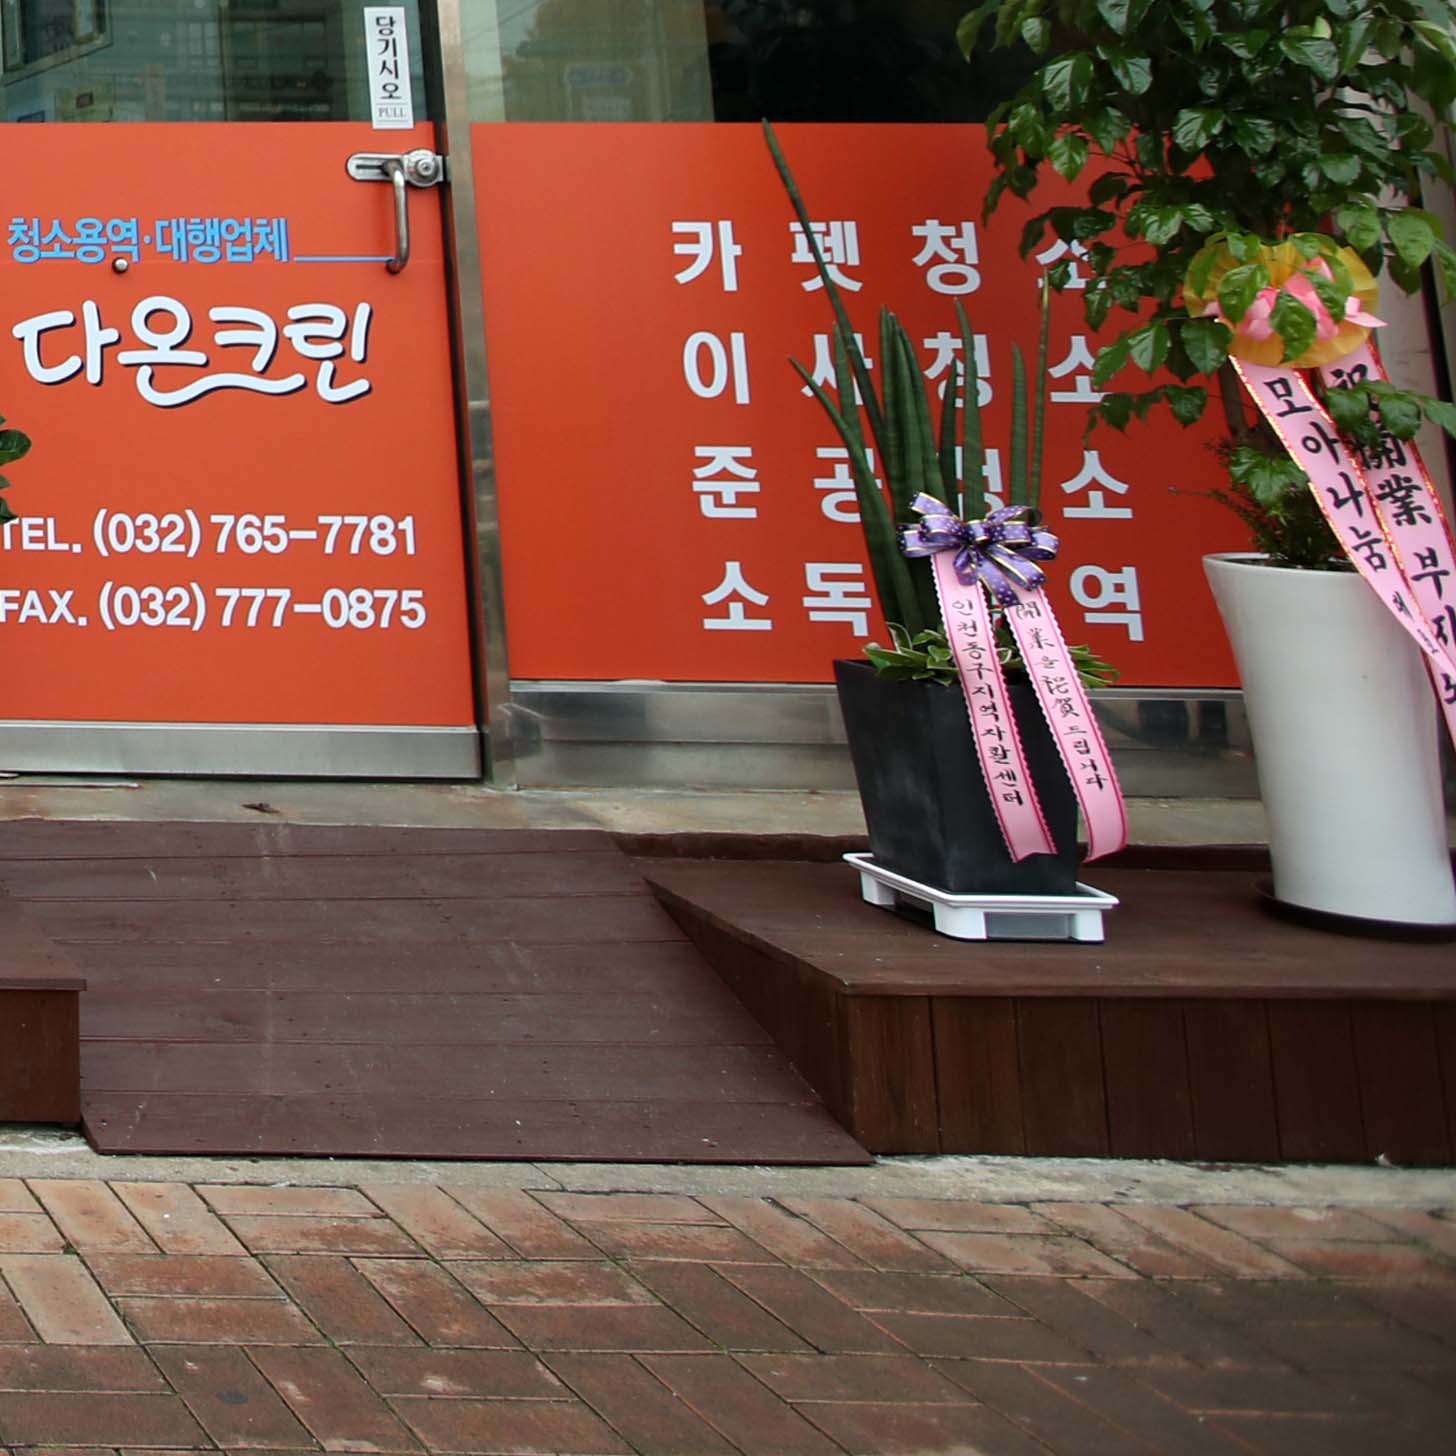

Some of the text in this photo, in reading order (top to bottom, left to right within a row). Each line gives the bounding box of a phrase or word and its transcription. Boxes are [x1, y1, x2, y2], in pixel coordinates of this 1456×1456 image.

[375, 15, 402, 100] 당기시오
[378, 107, 406, 118] PULL
[12, 295, 373, 408] 다온크린
[2, 509, 417, 558] TEL. (032) 765-7781
[98, 582, 206, 632] (032)
[215, 588, 427, 630] 777-0875
